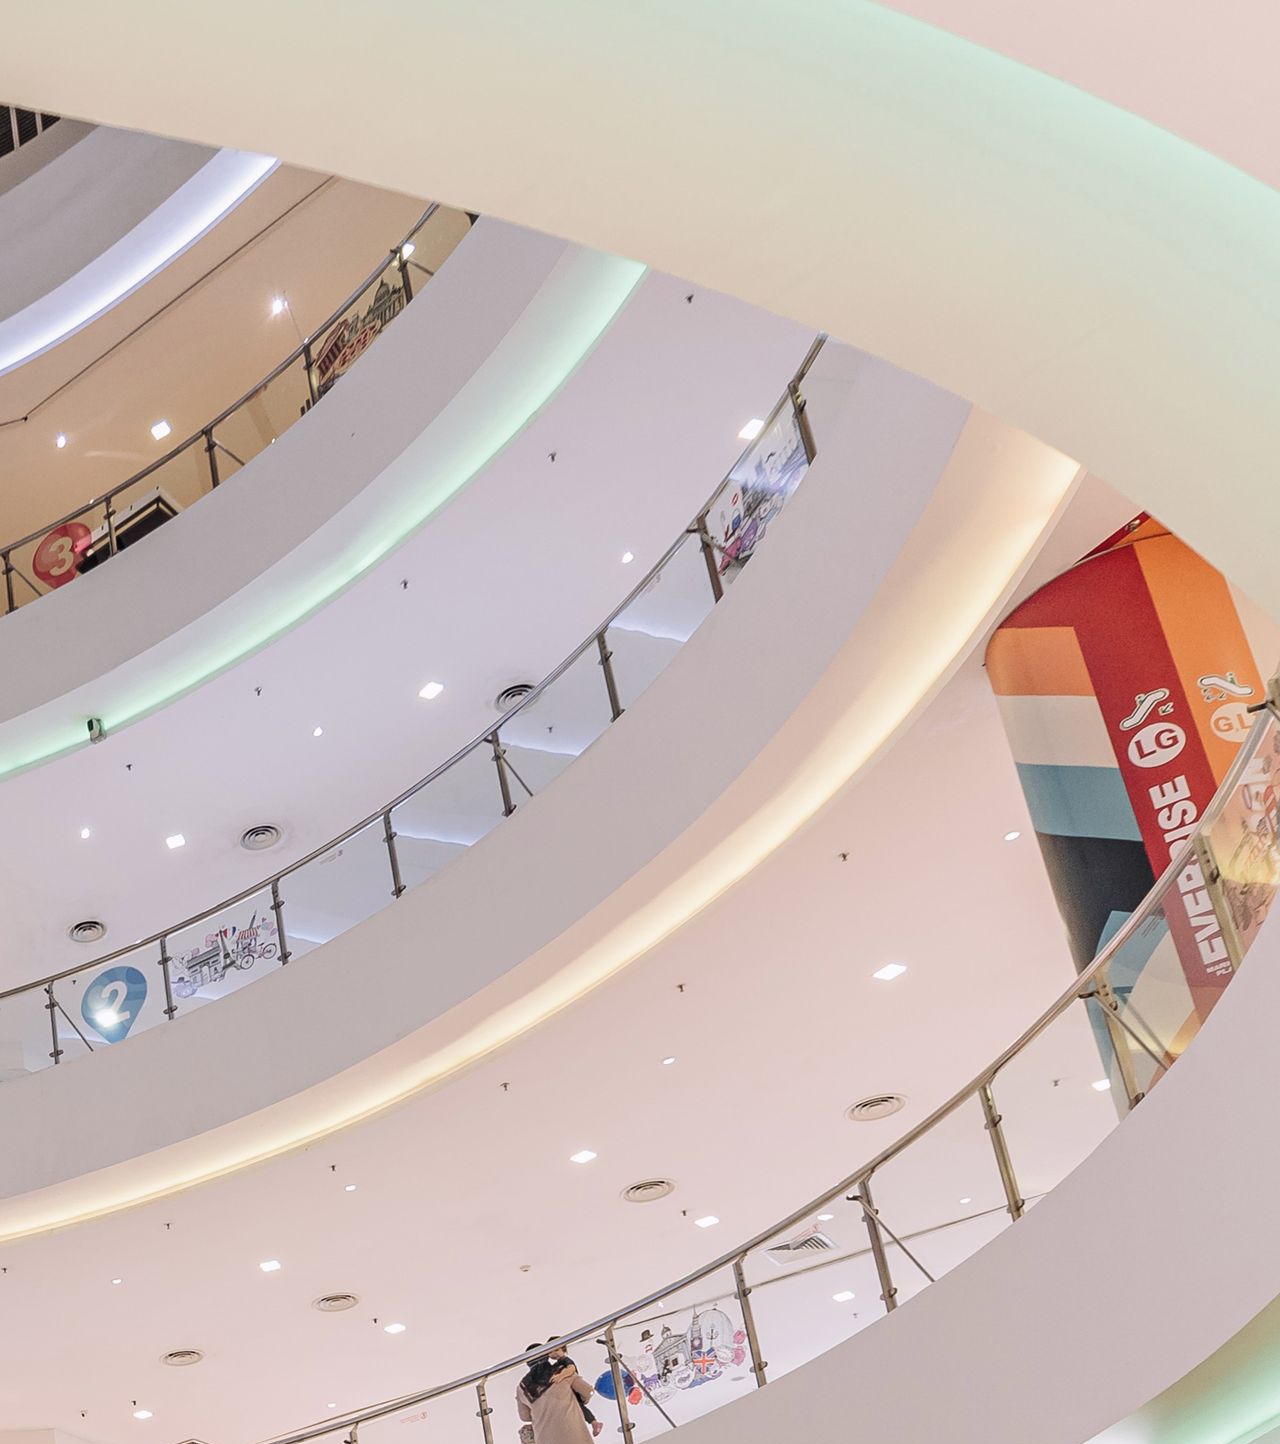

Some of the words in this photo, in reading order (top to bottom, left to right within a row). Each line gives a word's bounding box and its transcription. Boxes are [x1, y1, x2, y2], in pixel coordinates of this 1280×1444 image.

[47, 535, 75, 577] 3
[1134, 728, 1179, 760] LG
[96, 978, 131, 1024] 2
